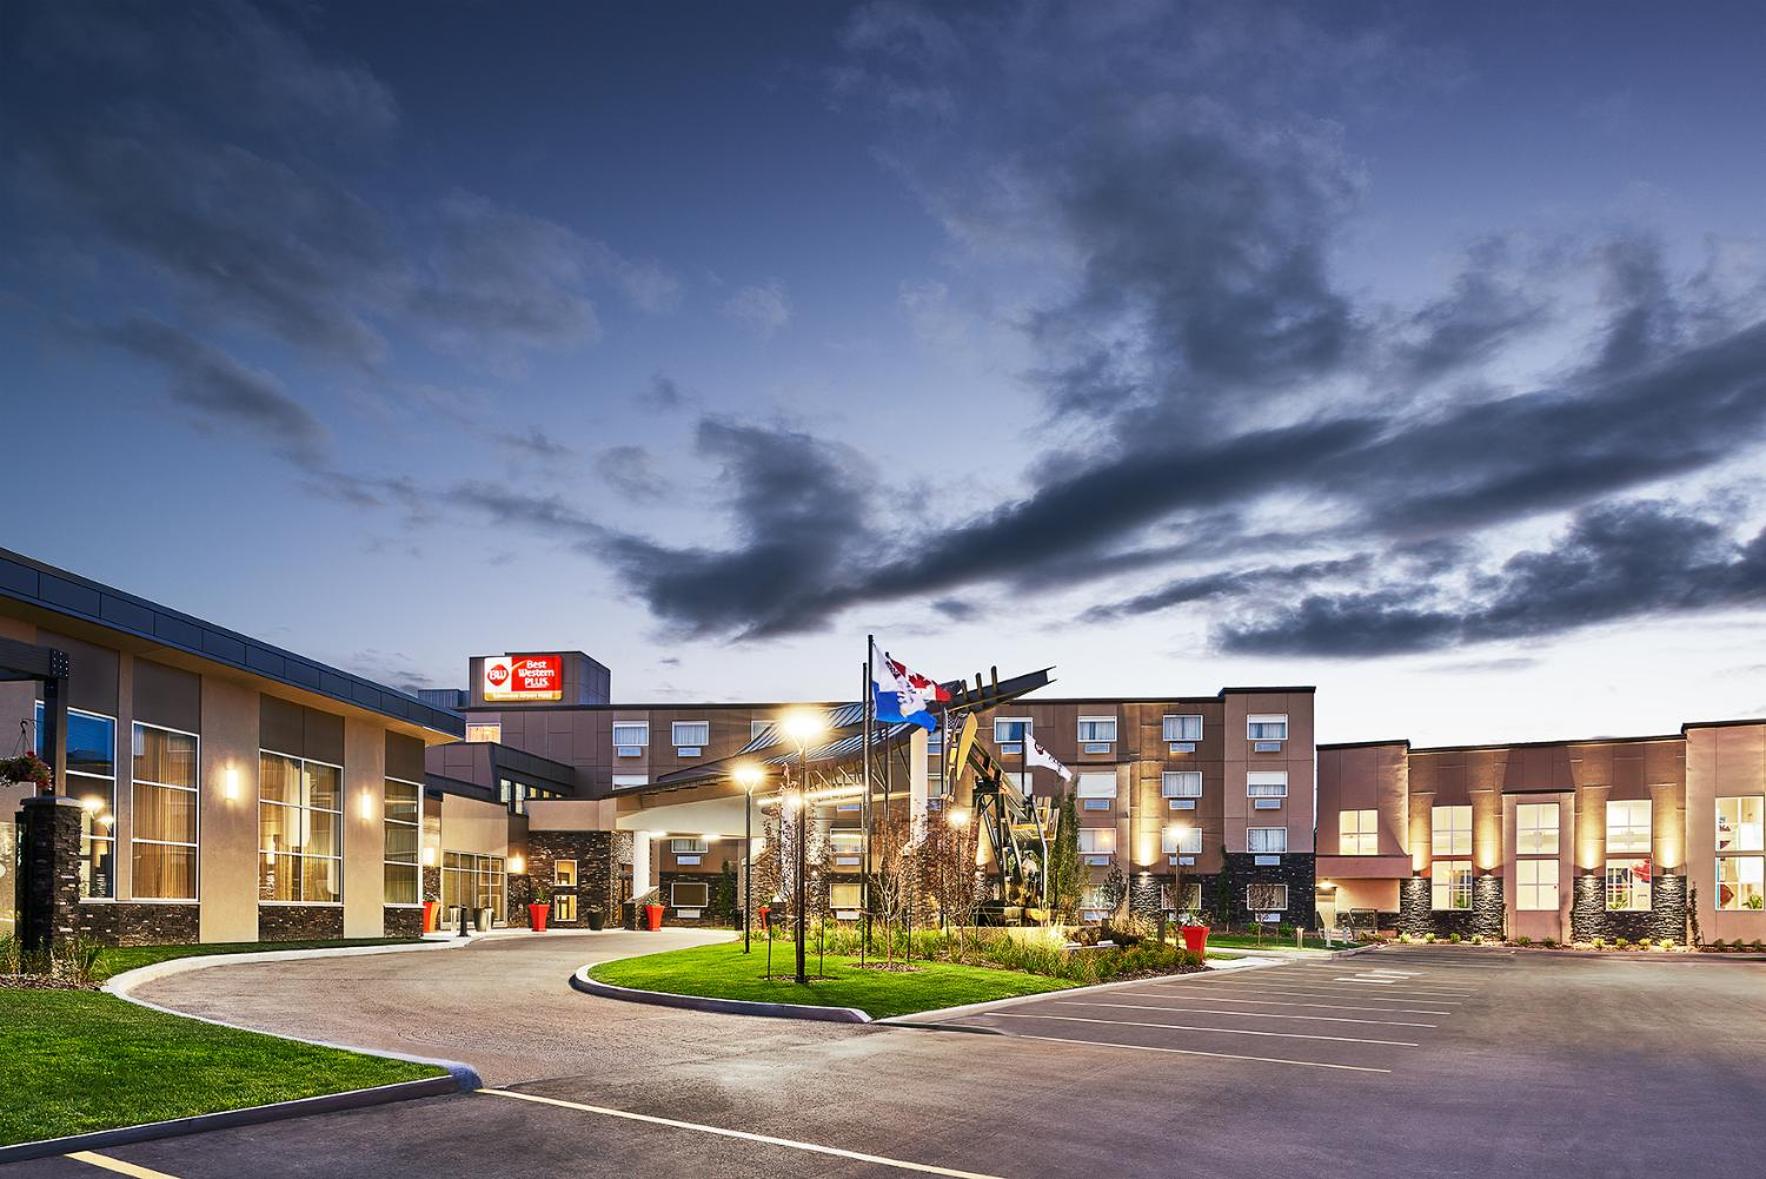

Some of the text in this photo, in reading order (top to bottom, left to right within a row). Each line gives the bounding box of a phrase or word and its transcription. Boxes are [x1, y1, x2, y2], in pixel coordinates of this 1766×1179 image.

[527, 660, 547, 668] Best
[489, 669, 507, 680] BW
[518, 668, 555, 677] Western
[525, 678, 548, 687] PLUS
